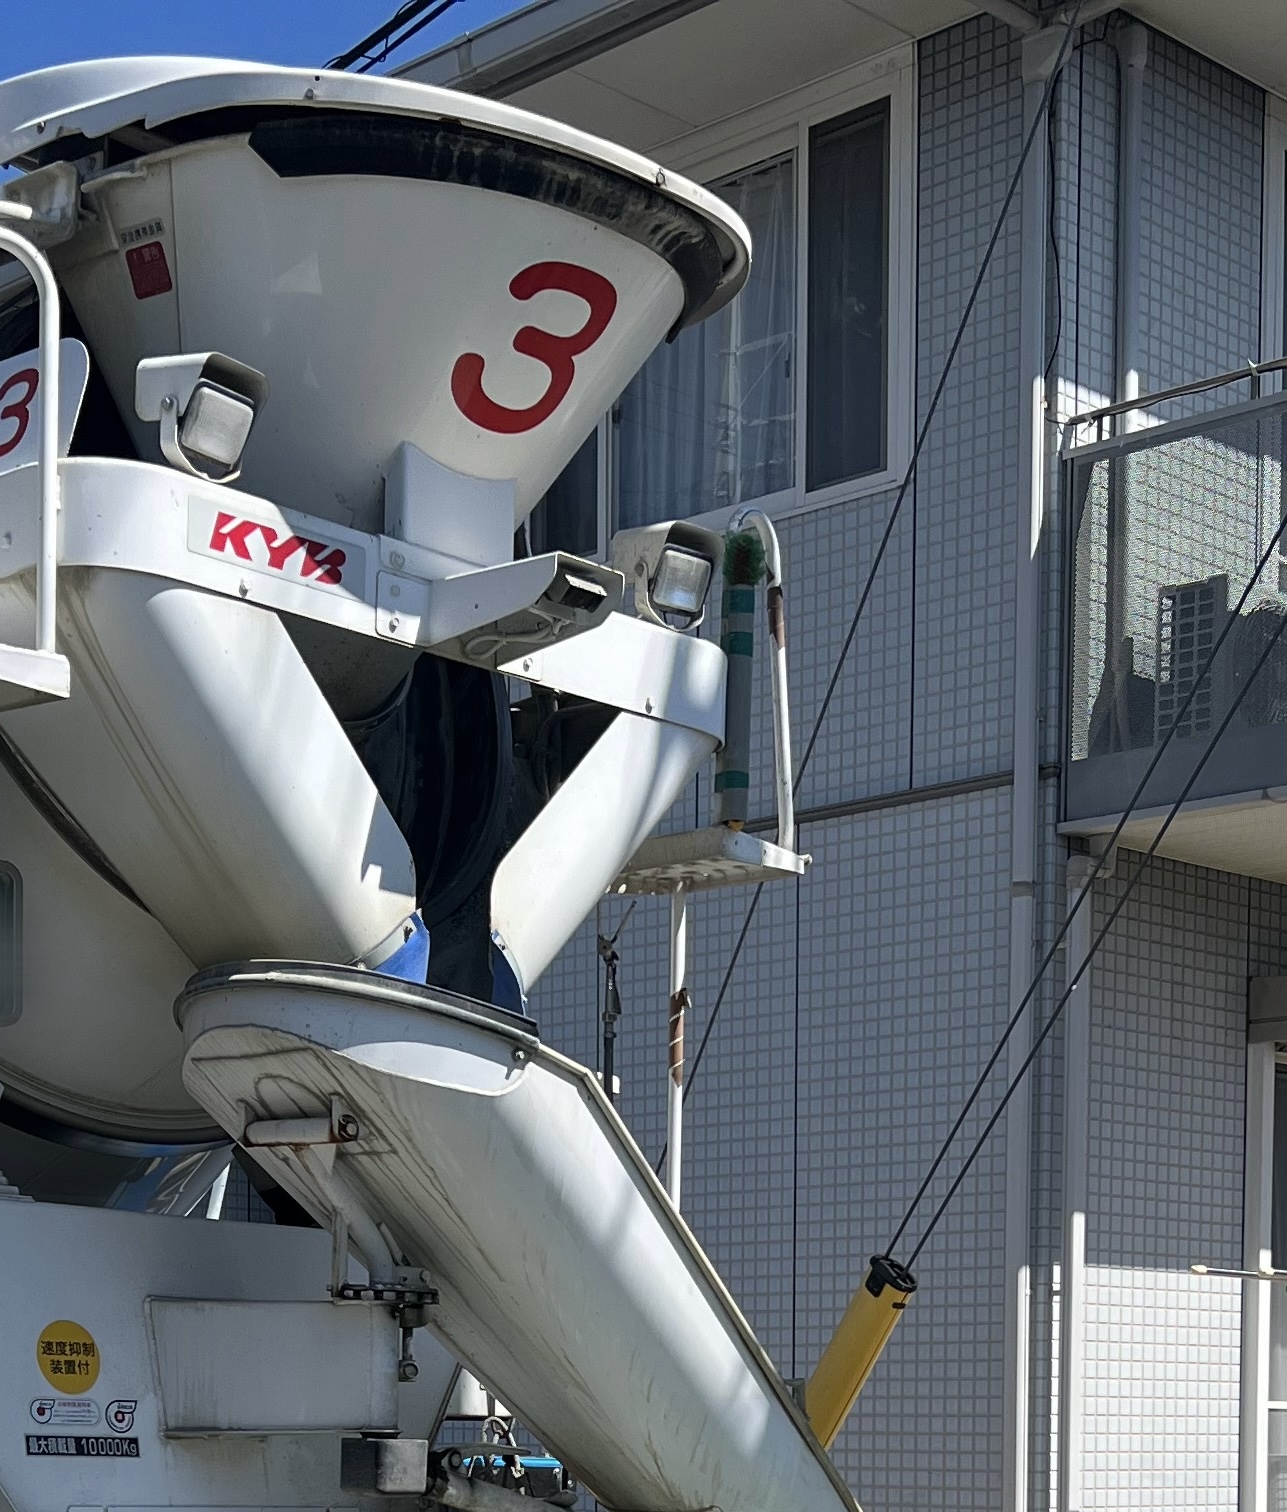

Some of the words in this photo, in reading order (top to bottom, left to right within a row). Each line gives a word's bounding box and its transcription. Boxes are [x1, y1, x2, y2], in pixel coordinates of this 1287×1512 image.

[450, 260, 618, 435] 3
[209, 511, 346, 585] KYB
[40, 1340, 96, 1357] 速度抑制
[49, 1359, 91, 1376] 装置付
